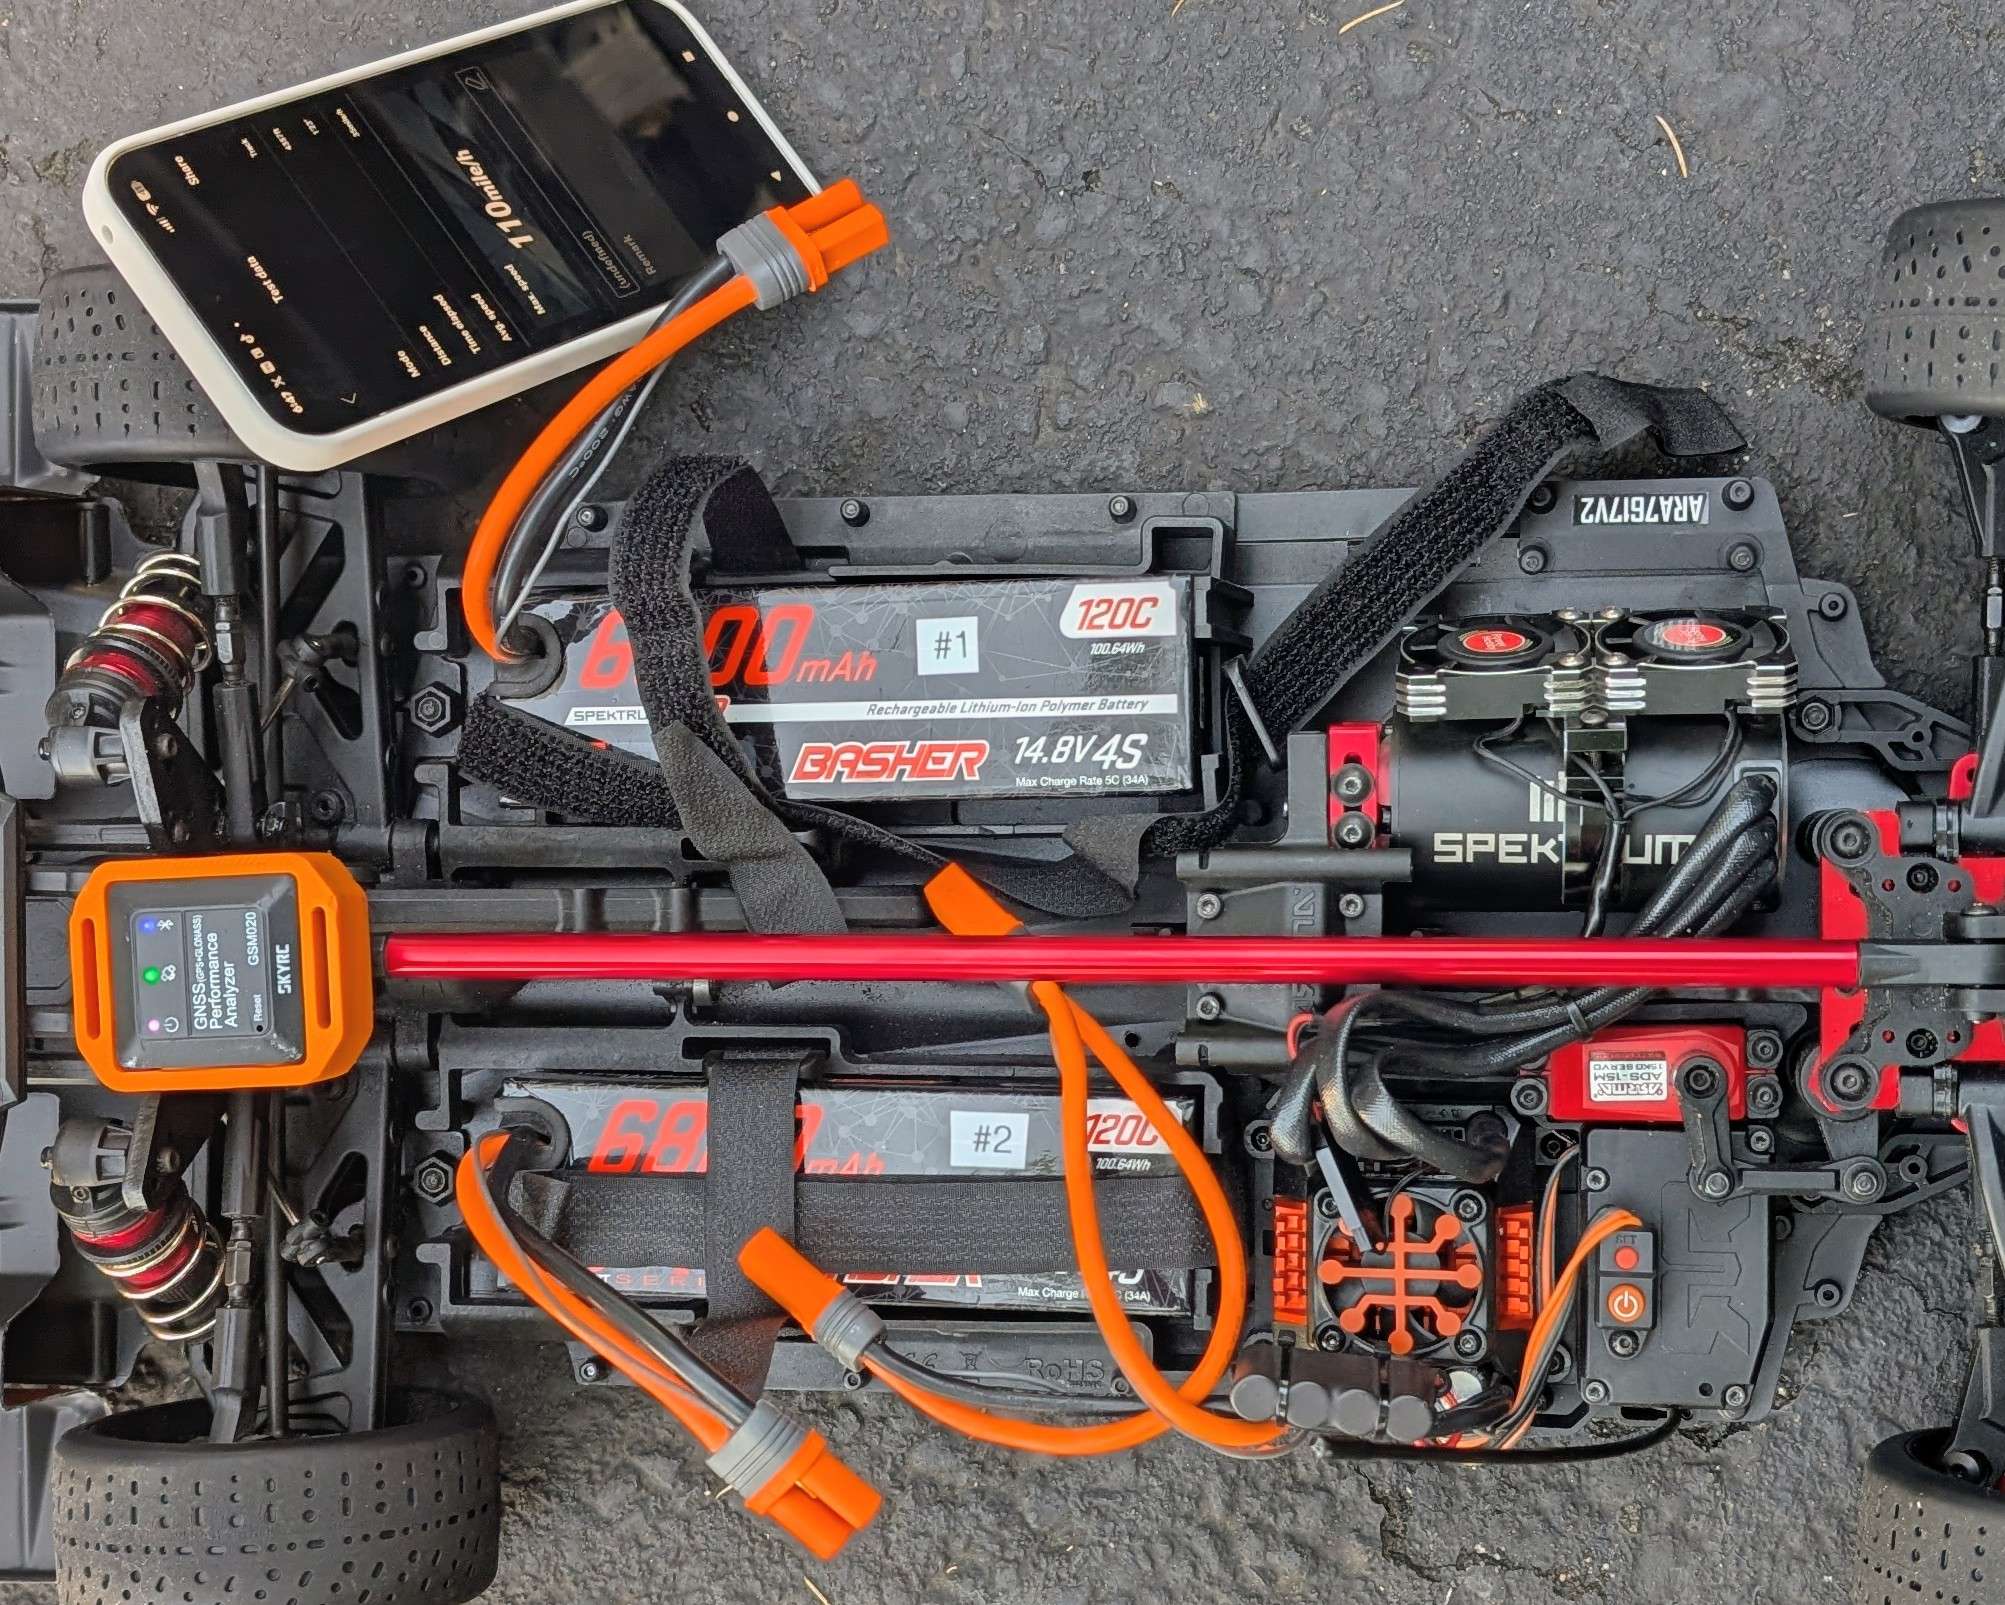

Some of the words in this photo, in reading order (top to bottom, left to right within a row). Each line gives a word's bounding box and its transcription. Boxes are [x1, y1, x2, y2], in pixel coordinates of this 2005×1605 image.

[240, 137, 258, 159] Track
[174, 155, 200, 186] Share
[455, 149, 534, 249] 110mile/h
[247, 255, 268, 279] data
[582, 230, 631, 289] (undefined)
[624, 233, 656, 276] Remark
[262, 278, 284, 304] Test
[504, 263, 529, 292] speed
[433, 293, 464, 330] elapsed
[471, 292, 496, 321] speed
[419, 325, 452, 366] Distance
[461, 328, 481, 355] Time
[495, 320, 512, 342] Avg.
[397, 350, 420, 378] Mode
[280, 391, 303, 414] 6:47
[1580, 495, 1704, 524] ARA7617V2
[1077, 597, 1160, 631] 120C
[933, 630, 967, 660] #1
[1090, 641, 1145, 656] 100.64Wh
[573, 709, 649, 722] SPEKTRU
[866, 701, 957, 717] Rechargeable
[960, 700, 1037, 714] Lithium-Ion
[1040, 699, 1095, 714] Polymer
[1097, 697, 1149, 712] Battery
[788, 740, 989, 784] BASHER
[1014, 734, 1100, 765] 14.8V
[1016, 776, 1038, 787] Max
[1040, 775, 1077, 788] Charge
[1079, 775, 1102, 787] Rate
[1104, 775, 1120, 787] 5C
[1122, 774, 1149, 787] (34A)
[1433, 833, 1697, 864] SPEKUM
[245, 911, 259, 966] GSM020
[207, 933, 222, 1029] Performance
[276, 944, 292, 994] SKYRC
[224, 961, 239, 1027] Analyzer
[253, 994, 263, 1021] Reset
[1593, 1063, 1633, 1071] SERVO
[973, 1125, 1013, 1154] #2
[1096, 1157, 1152, 1171] 100.64Wh
[1018, 1287, 1040, 1298] Max
[1042, 1286, 1079, 1300] Charge
[1124, 1290, 1151, 1303] (34A)
[1025, 1357, 1105, 1381] RoHS
